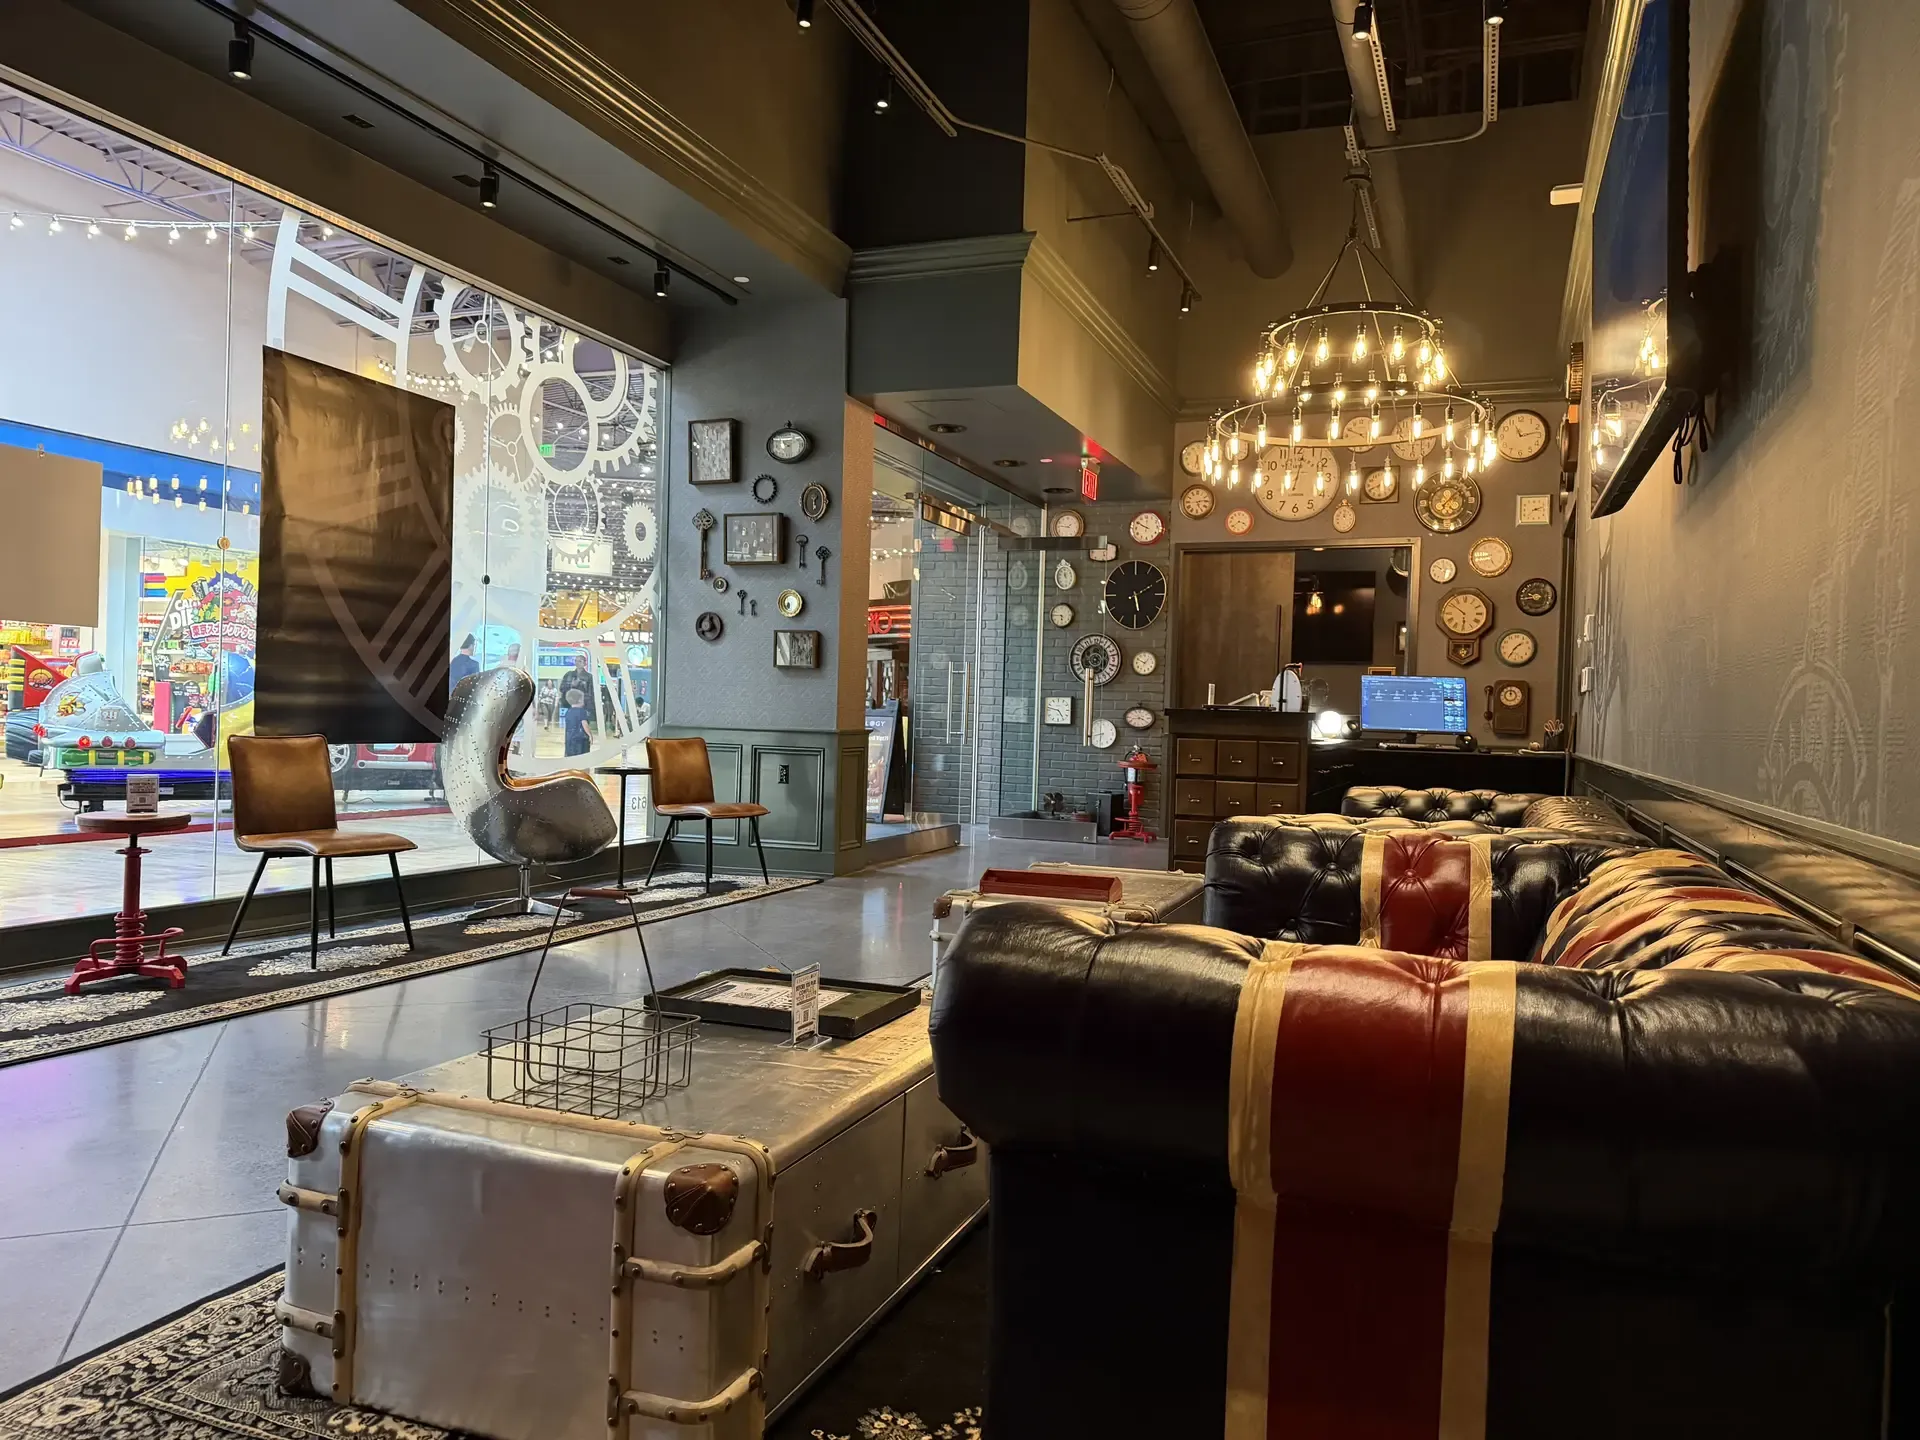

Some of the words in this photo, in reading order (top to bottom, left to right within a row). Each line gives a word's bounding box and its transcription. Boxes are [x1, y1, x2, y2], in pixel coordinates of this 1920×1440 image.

[1280, 449, 1287, 459] 11
[1267, 461, 1277, 471] 10
[1322, 458, 1327, 467] 2
[1263, 475, 1269, 485] 9
[1325, 473, 1331, 482] 3
[1266, 490, 1273, 499] 8
[1279, 501, 1285, 510] 7
[1292, 504, 1298, 513] 6
[1307, 500, 1314, 509] 5
